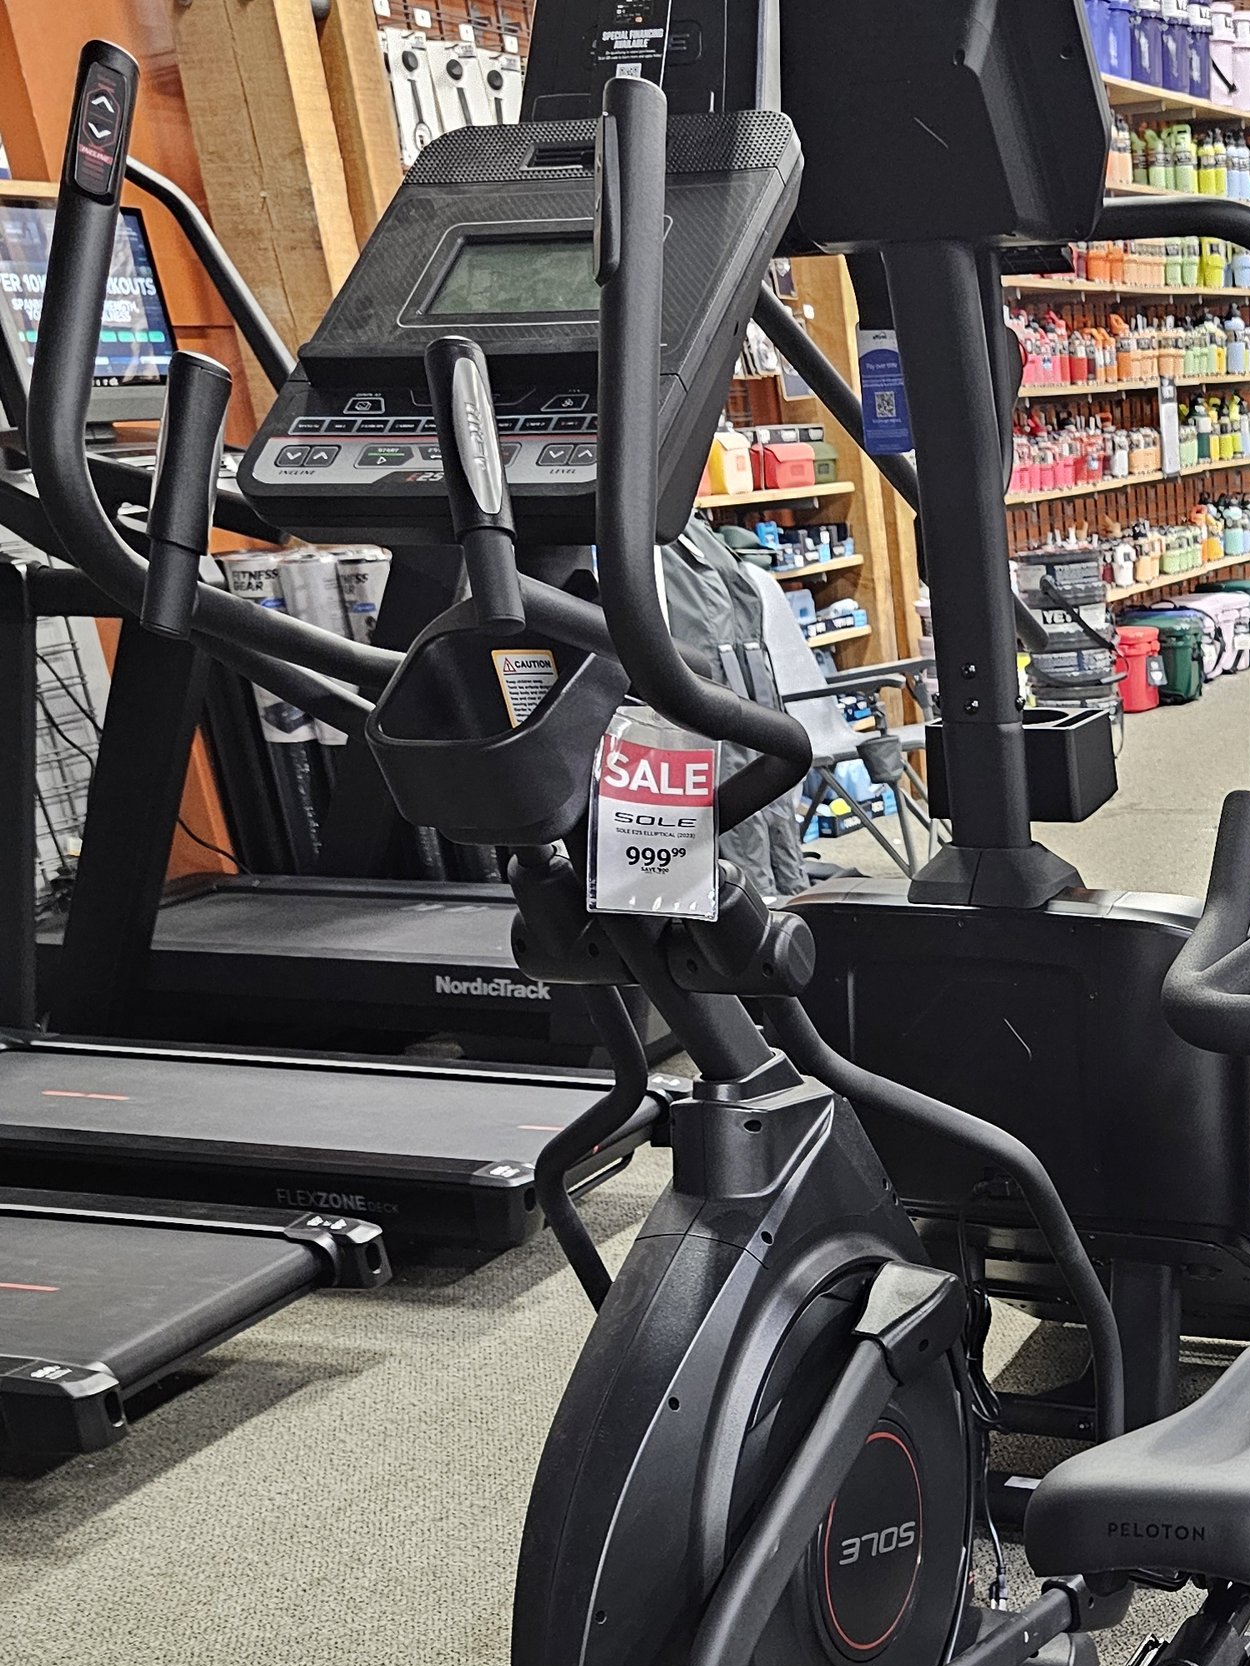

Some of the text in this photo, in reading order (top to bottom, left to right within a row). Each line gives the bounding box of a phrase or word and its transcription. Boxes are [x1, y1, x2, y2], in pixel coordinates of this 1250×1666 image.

[406, 471, 445, 482] E25
[232, 569, 278, 580] FITNESS
[233, 581, 264, 591] GEAR
[514, 660, 552, 668] CAUTION
[604, 752, 709, 796] SALE
[614, 811, 697, 828] SOLE
[643, 829, 676, 838] ELLIPTICAL
[677, 831, 696, 839] (2023)
[435, 975, 551, 1000] NordicTrack
[275, 1188, 399, 1213] FLEXZONE DECK
[1107, 1522, 1205, 1541] PELOTON
[839, 1521, 916, 1566] SOLE
